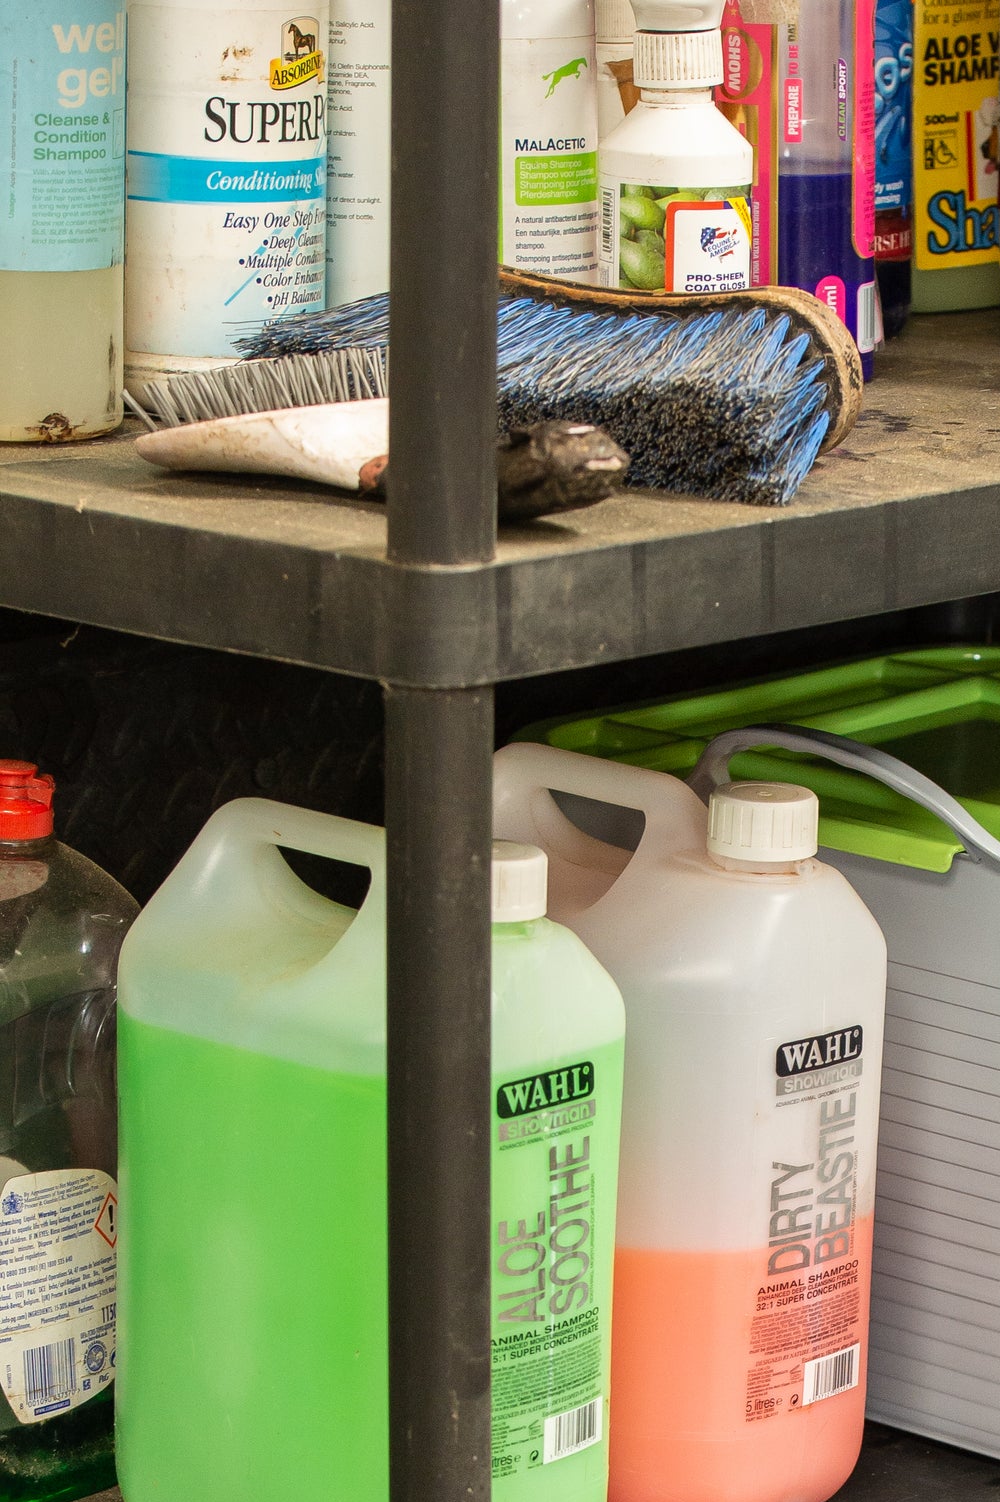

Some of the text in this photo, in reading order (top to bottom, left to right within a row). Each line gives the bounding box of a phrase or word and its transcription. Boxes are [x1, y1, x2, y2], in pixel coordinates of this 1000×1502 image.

[335, 21, 358, 29] Salicylic
[789, 45, 799, 59] BE
[924, 33, 981, 62] ALOE
[728, 35, 741, 91] SHOW
[789, 62, 799, 75] TO
[345, 80, 376, 88] Fragrance,
[839, 64, 847, 99] SPORT
[34, 112, 110, 126] Cleanse &
[788, 85, 799, 135] PREPARE
[33, 130, 107, 143] Condition
[33, 147, 106, 162] Shampoo
[520, 160, 581, 171] Equine Shampoo
[206, 170, 313, 194] Conditioning
[520, 171, 559, 181] Shampoo
[520, 180, 565, 190] Shampoing
[357, 197, 382, 205] sunlight.
[520, 190, 578, 199] Pferdeshampoo
[223, 212, 259, 233] Easy
[264, 212, 290, 228] One
[293, 210, 313, 230] Step
[927, 188, 1000, 255] Sha
[707, 236, 732, 253] EQUINE
[685, 281, 746, 292] COAT GLOSS
[687, 272, 744, 282] PRO-SHEEN
[782, 1030, 859, 1072] WAHL
[503, 1067, 589, 1114] WAHL
[784, 1064, 857, 1094] showman
[776, 1097, 799, 1108] ADVANCED
[801, 1092, 816, 1102] ANIMAL
[840, 1082, 860, 1094] PRODUCTS
[507, 1104, 590, 1139] showman
[499, 1141, 525, 1151] ADVANCED
[571, 1121, 594, 1133] PRODUCTS
[814, 1092, 856, 1265] BEASTIE
[550, 1136, 590, 1315] SOOTHE
[768, 1161, 814, 1276] DIRTY
[498, 1211, 545, 1323] ALOE
[757, 1259, 859, 1295] ANIMAL SHAMPOO
[756, 1275, 858, 1312] 32:1 SUPER CONCENTRATE
[757, 1269, 858, 1302] ENHANCED DEEP CLEANSING FORMULA
[491, 1307, 599, 1346] ANIMAL SHAMPOO
[492, 1323, 599, 1363] 5:1 SUPER CONCENTRATE
[755, 1397, 775, 1411] litres
